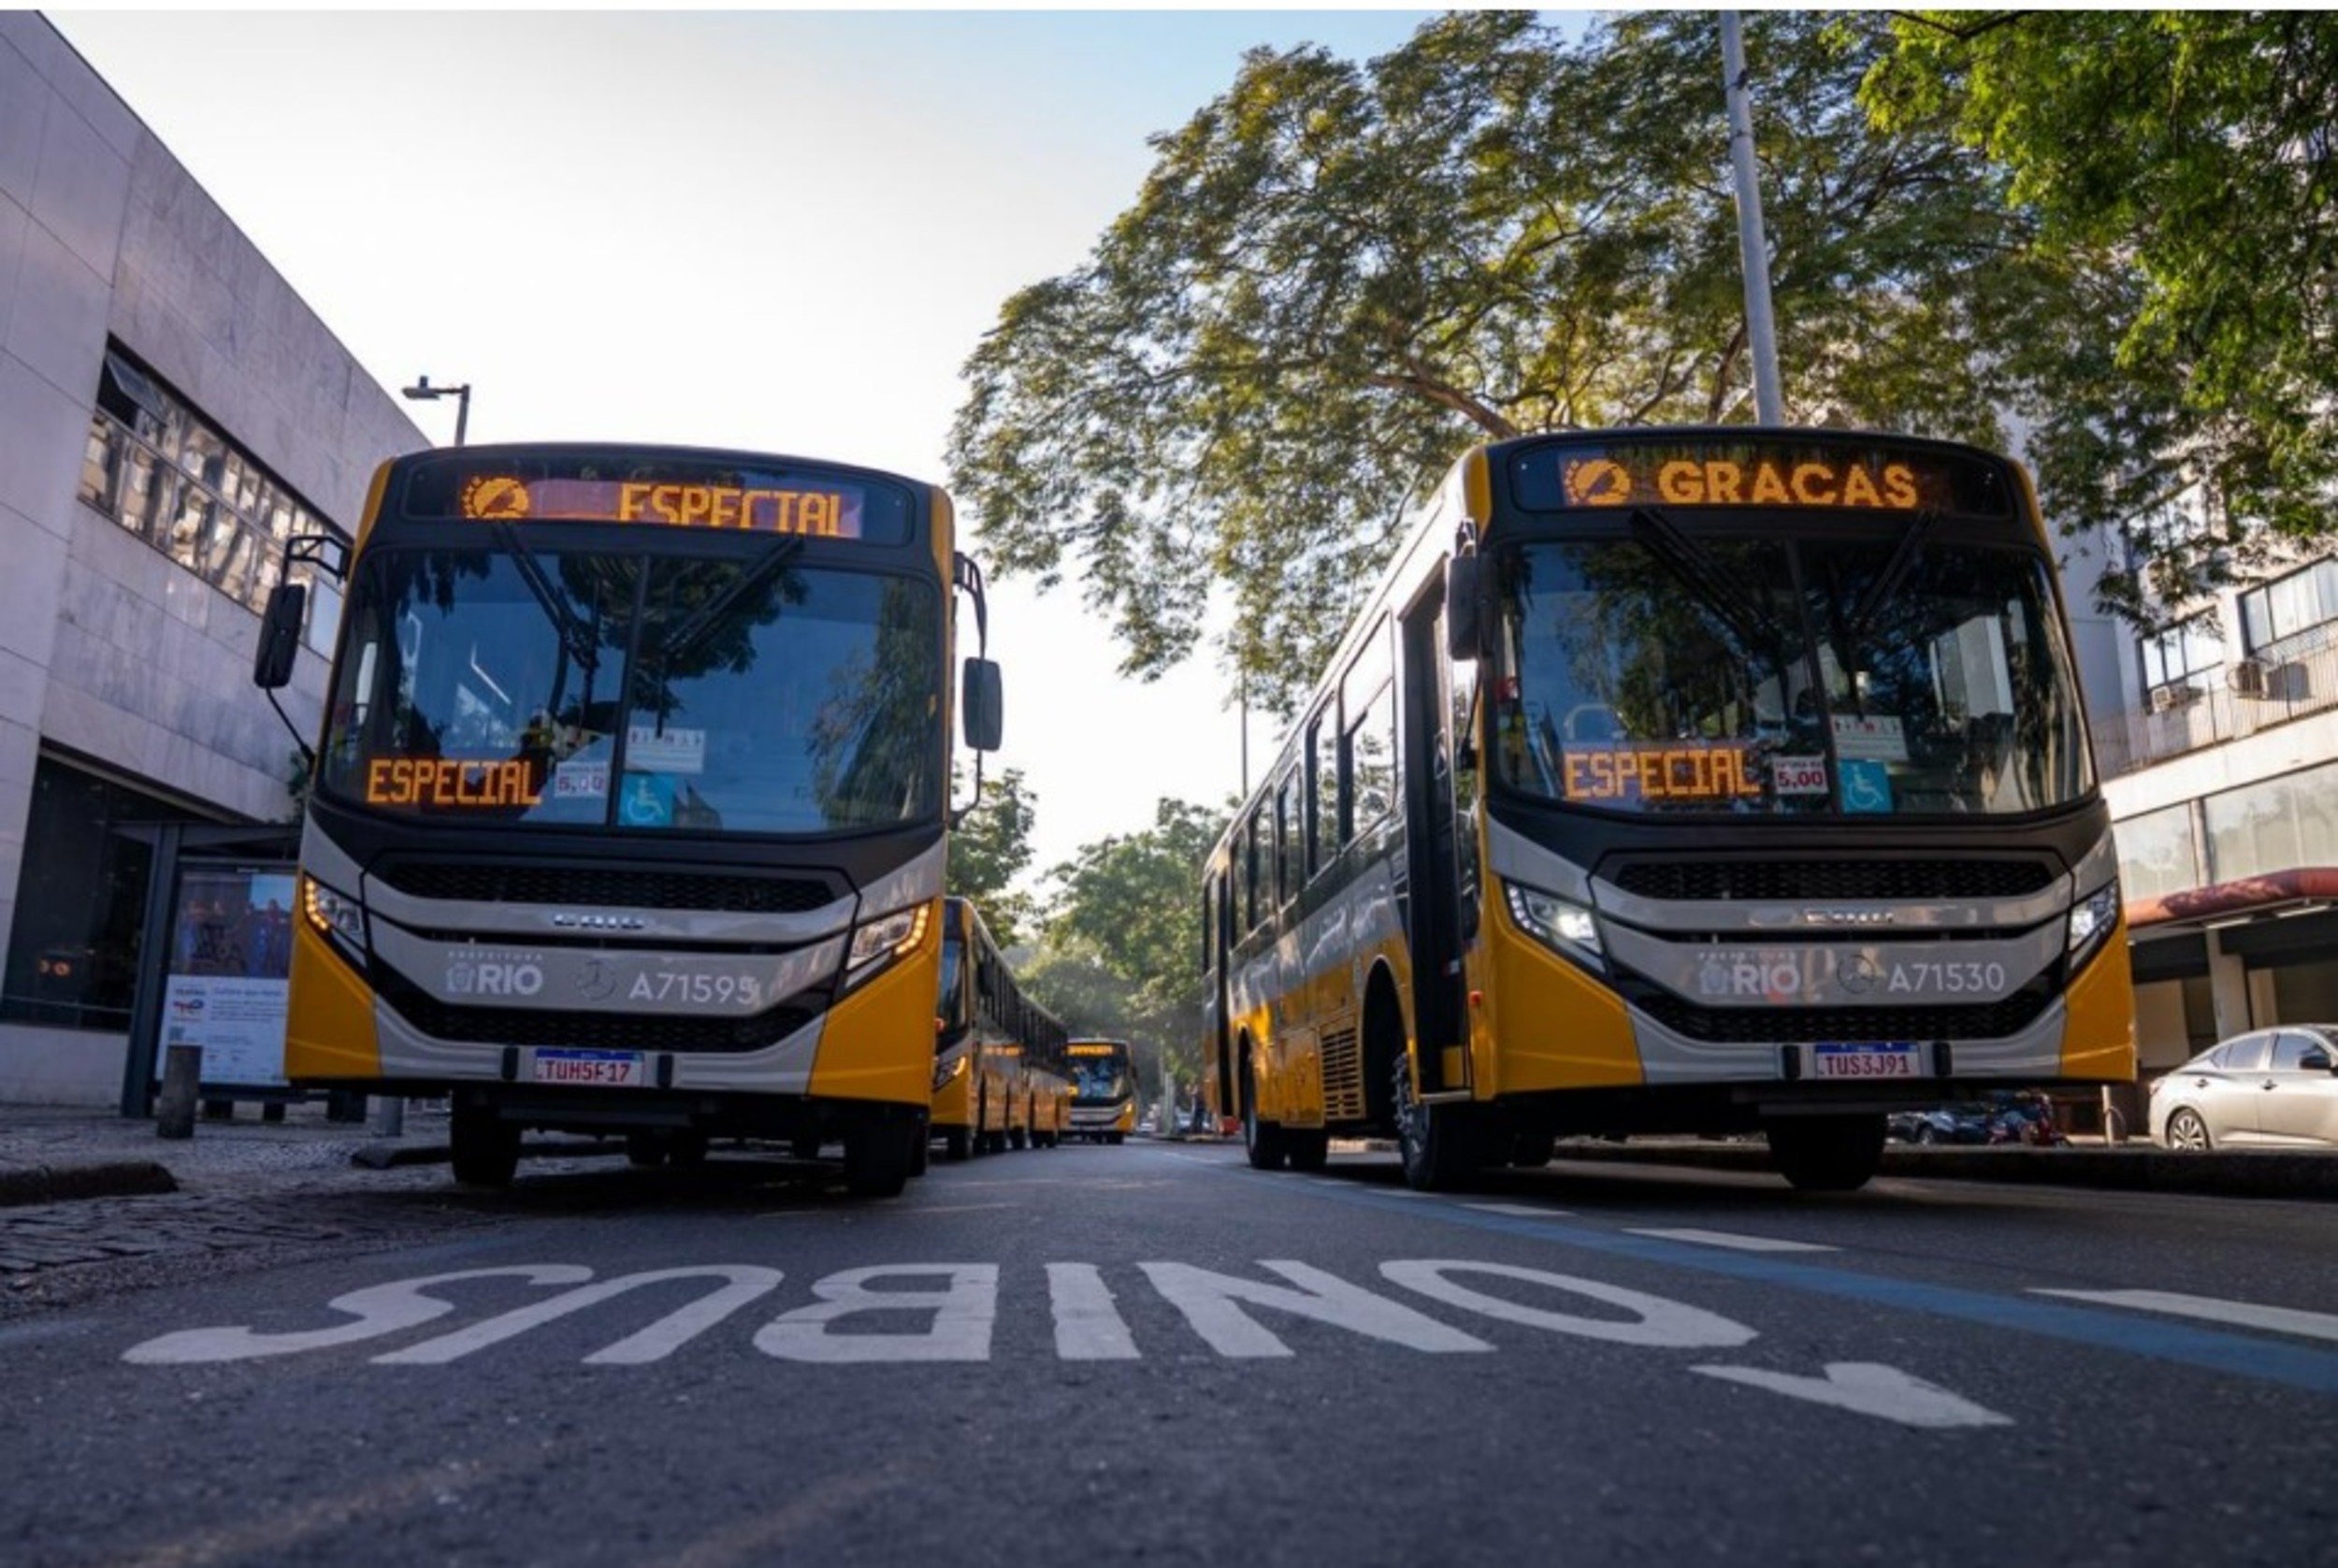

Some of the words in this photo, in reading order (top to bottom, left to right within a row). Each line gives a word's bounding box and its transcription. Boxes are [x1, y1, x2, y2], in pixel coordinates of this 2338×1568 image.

[1657, 461, 1918, 509] GRACAS
[368, 759, 541, 805] ESPECIAL
[1565, 749, 1760, 798] ESPECIAL
[1778, 771, 1824, 788] 5,00
[477, 964, 544, 996] RIO
[1733, 965, 1801, 995] RIO
[1887, 962, 2006, 993] A71530
[1826, 1054, 1911, 1075] TUS3J91
